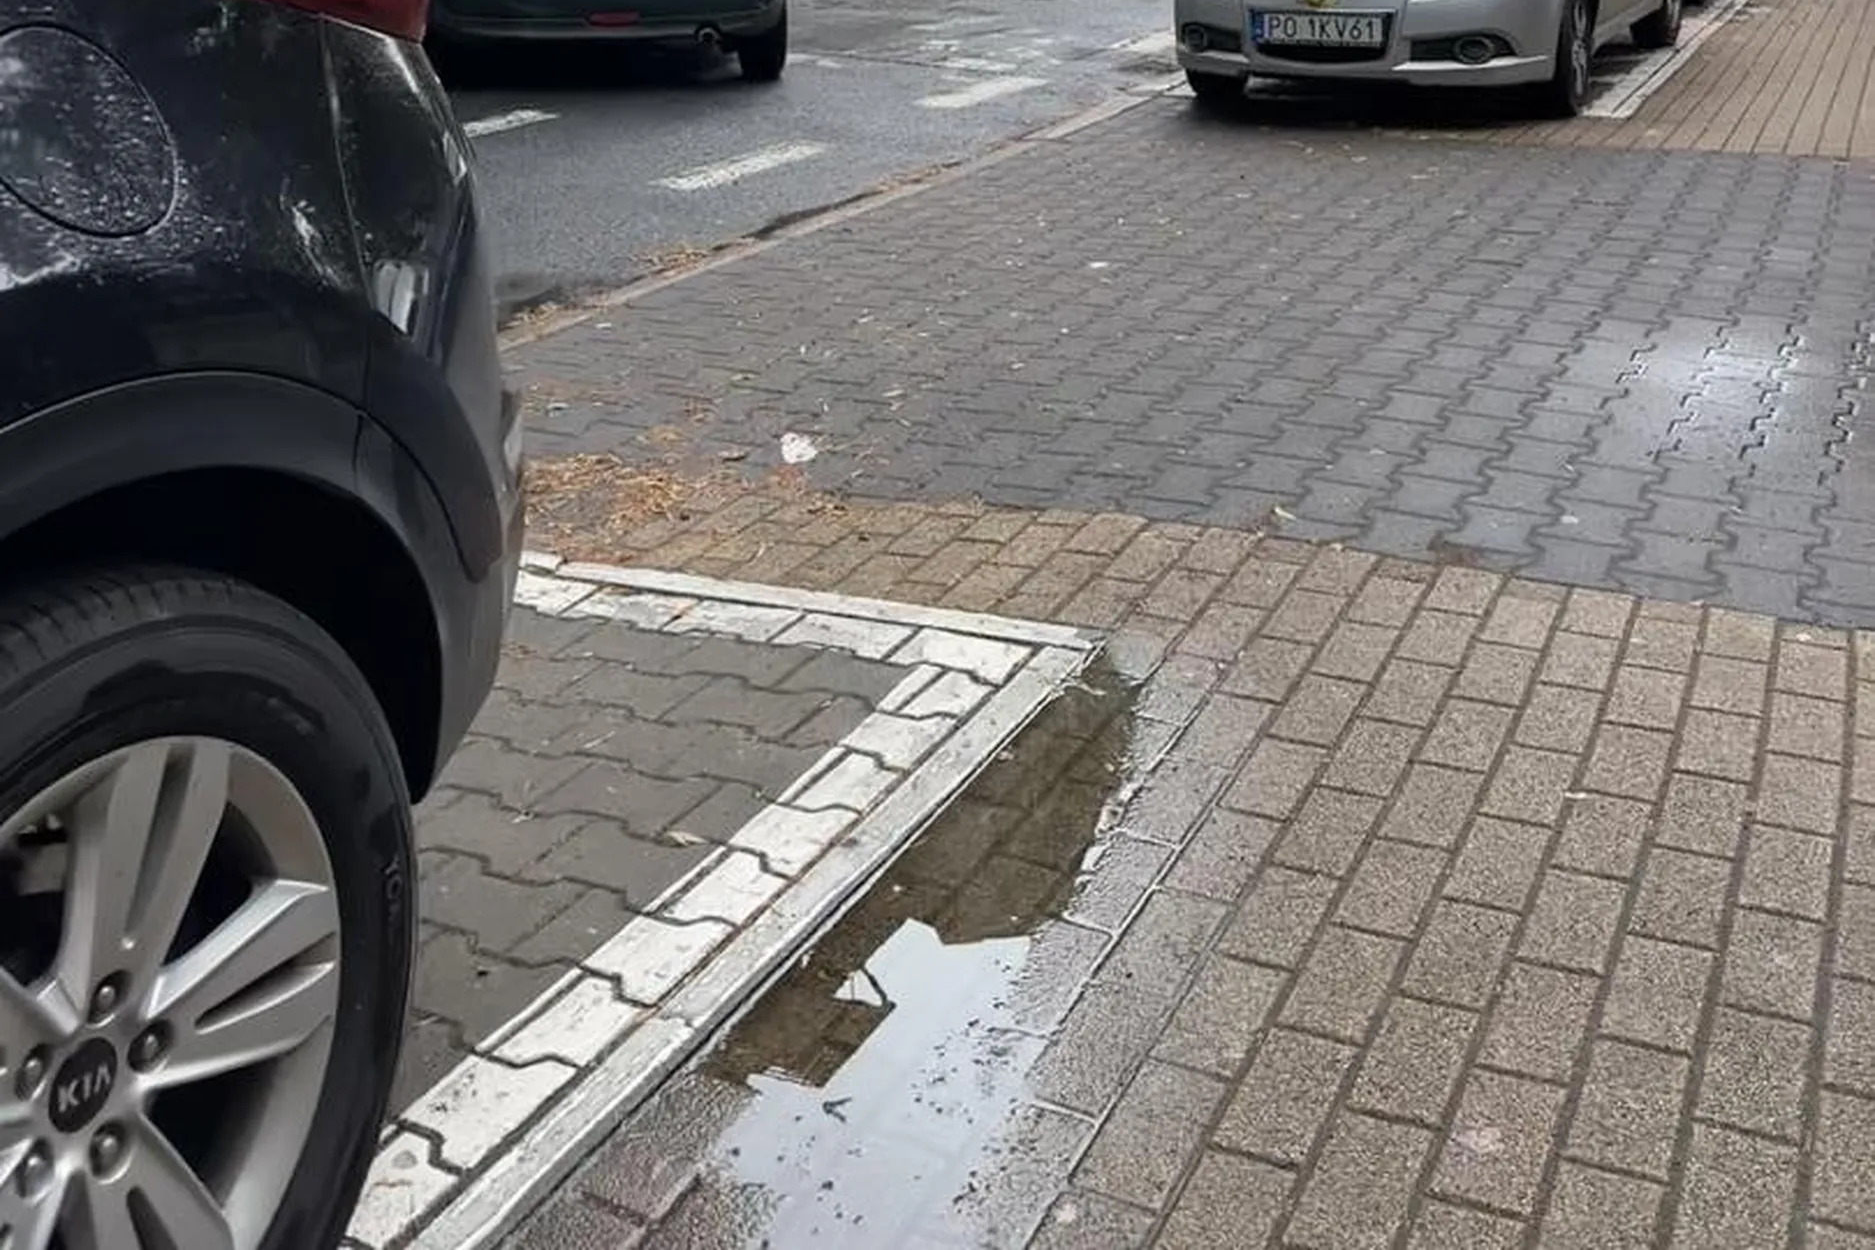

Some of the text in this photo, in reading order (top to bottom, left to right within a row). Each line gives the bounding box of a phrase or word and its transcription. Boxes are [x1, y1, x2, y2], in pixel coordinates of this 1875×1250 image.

[1268, 15, 1375, 40] PO 1KV61
[58, 1063, 112, 1113] KIA
